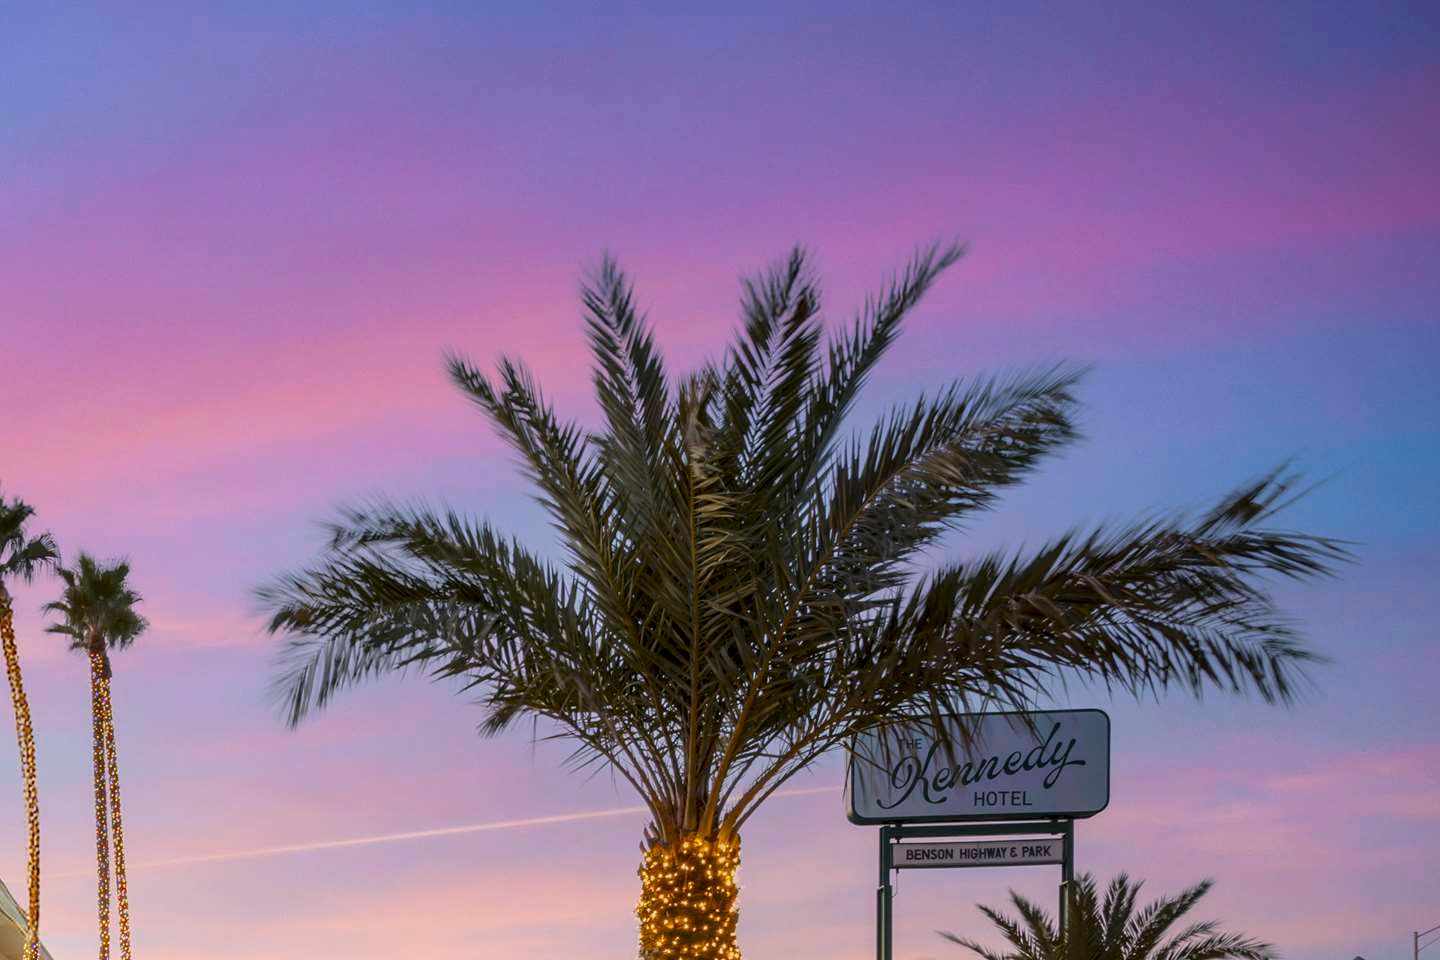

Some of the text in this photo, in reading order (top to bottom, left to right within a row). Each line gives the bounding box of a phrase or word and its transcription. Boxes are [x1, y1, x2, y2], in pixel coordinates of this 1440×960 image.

[876, 722, 1086, 809] Kennedy
[973, 791, 1032, 807] HOTEL
[905, 845, 1052, 861] BENSON HIGHWAY & PARK
